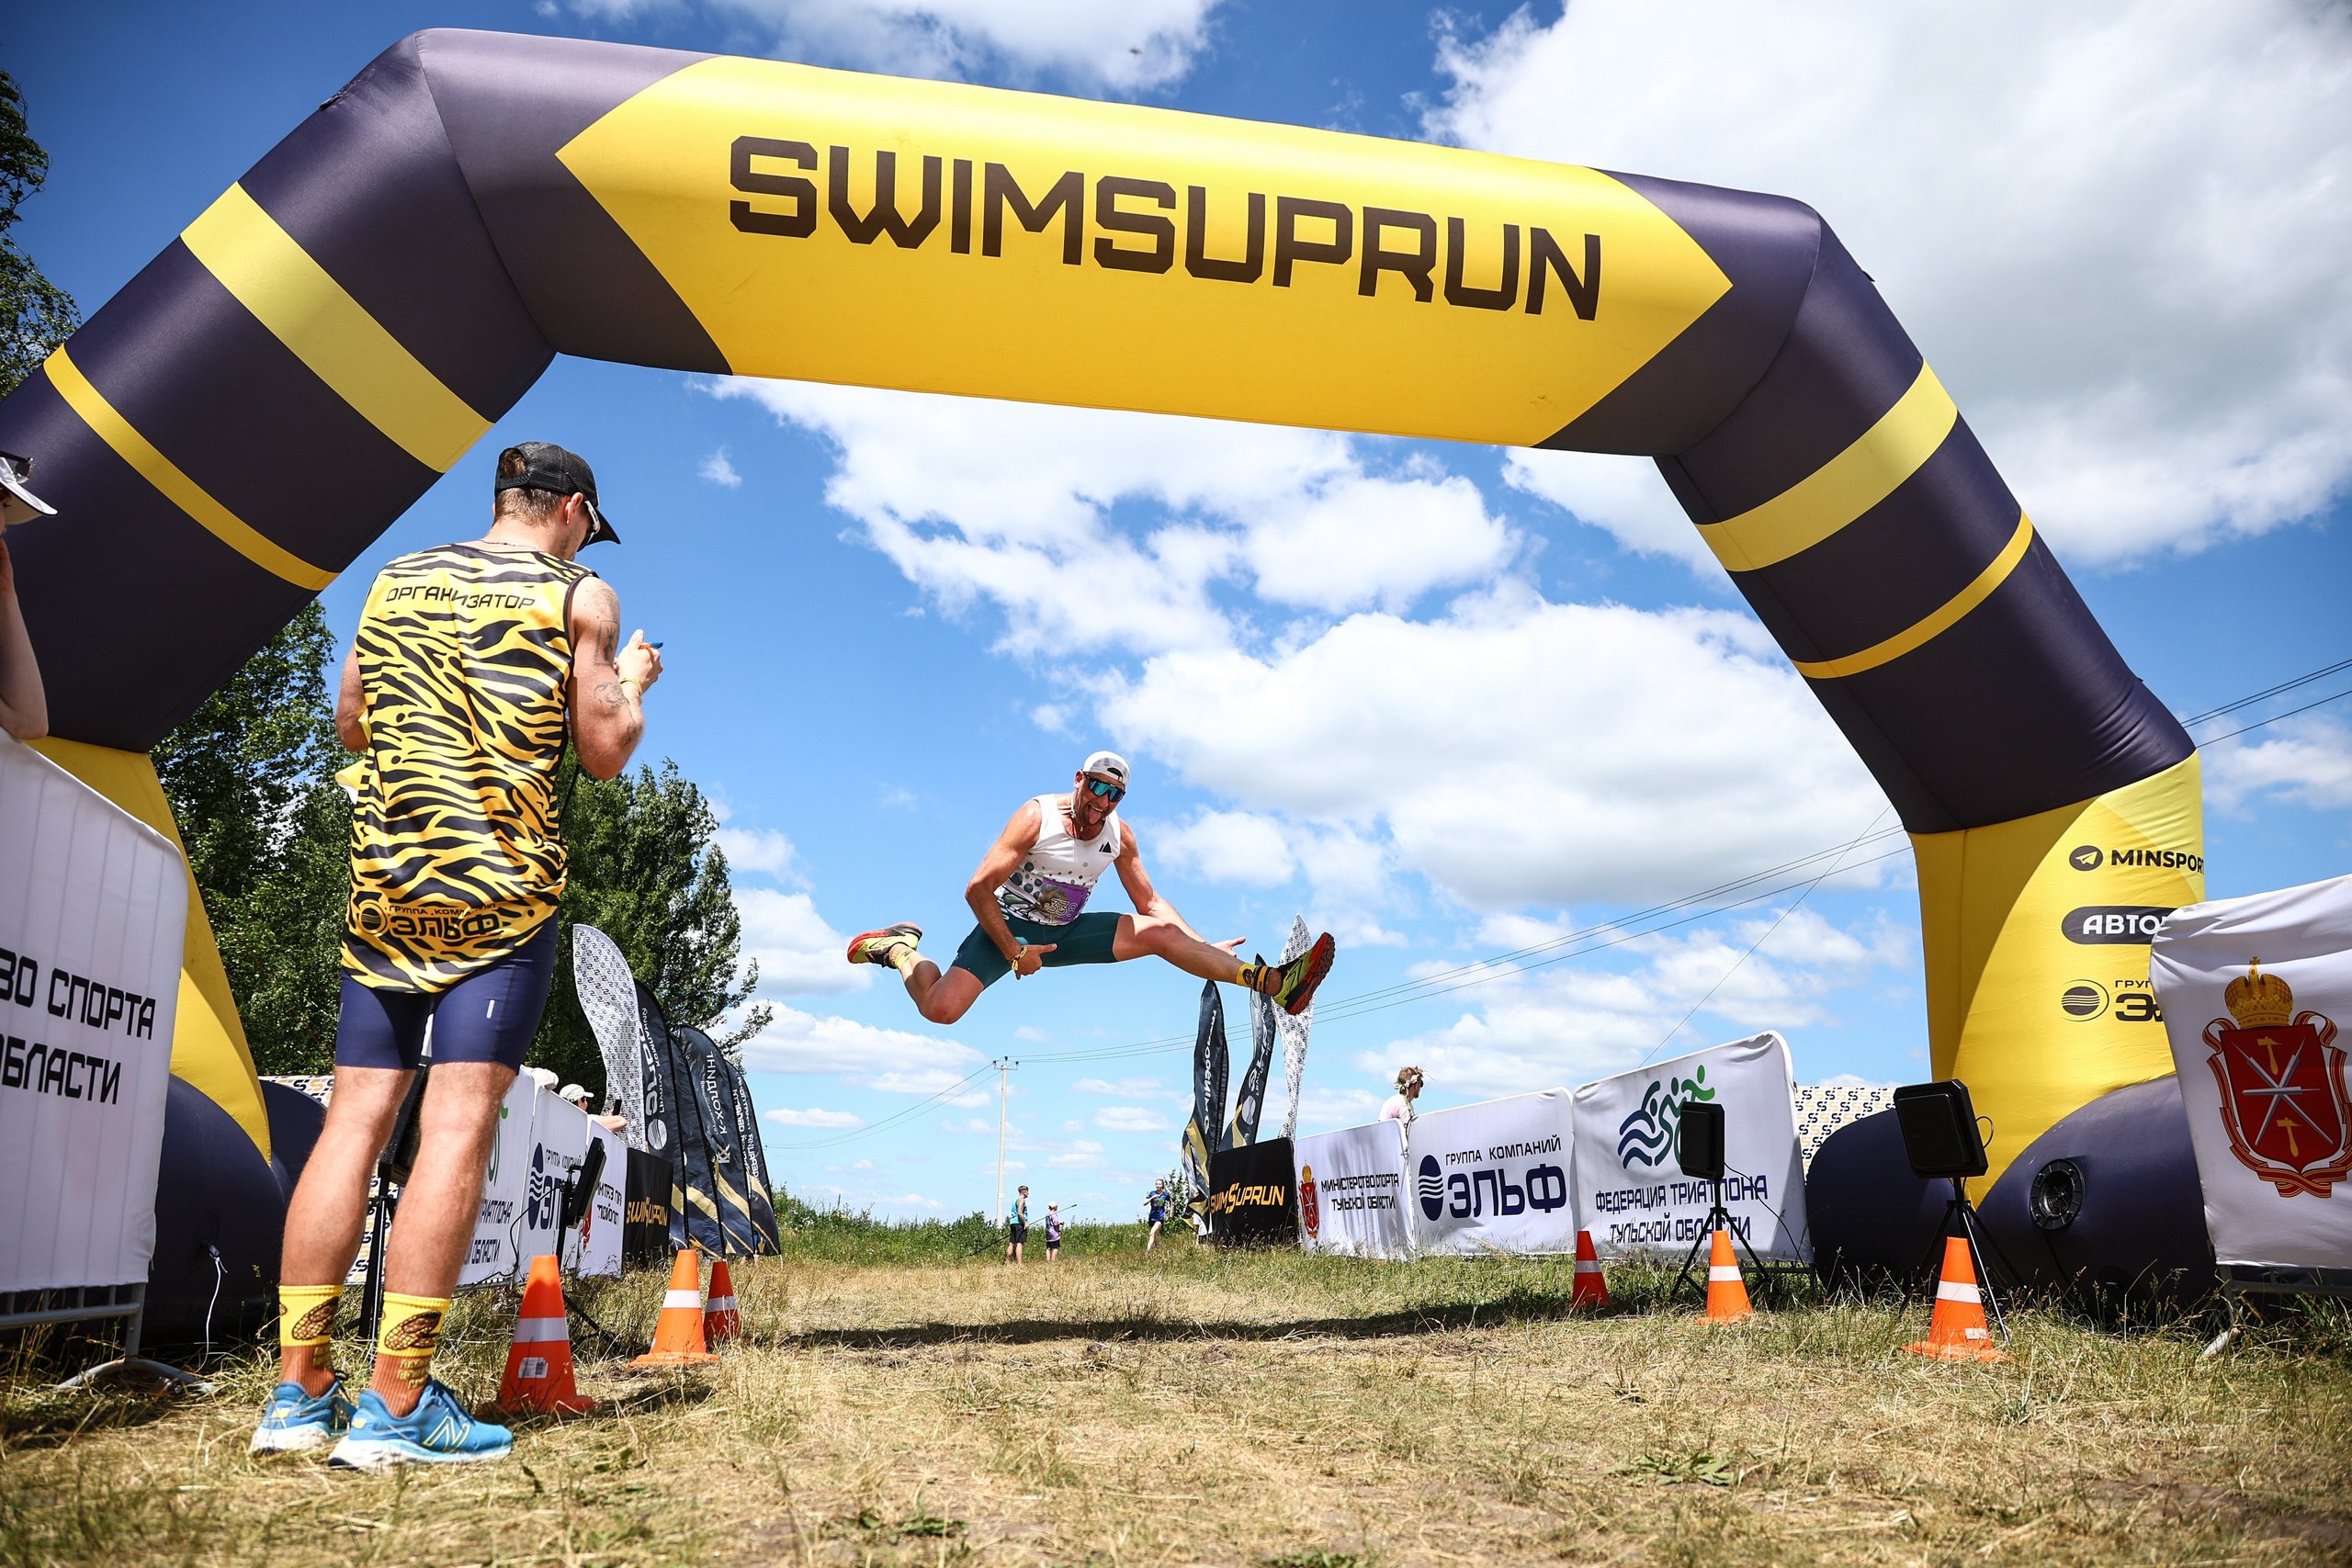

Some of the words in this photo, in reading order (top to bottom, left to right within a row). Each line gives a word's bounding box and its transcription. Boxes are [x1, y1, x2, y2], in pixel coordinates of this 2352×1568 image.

[729, 135, 1601, 321] SWIMSUPRUN
[385, 585, 536, 609] ОРГАНИЗАТОР
[1047, 897, 1078, 918] 338
[390, 914, 500, 940] ЭЛЬФ
[2083, 914, 2166, 935] АВТО
[47, 968, 156, 1040] СПОРТА
[0, 1033, 121, 1105] БЛАСТИ
[1445, 1148, 1482, 1166] ГРУППА
[1488, 1134, 1562, 1161] КОМПАНИЙ
[1210, 1182, 1284, 1214] SWIMSUPRUN
[1447, 1163, 1567, 1219] ЭЛЬФ
[1595, 1185, 1667, 1214] ФЕДЕРАЦИЯ
[1610, 1213, 1671, 1244] ТУЛЬСКОЙ
